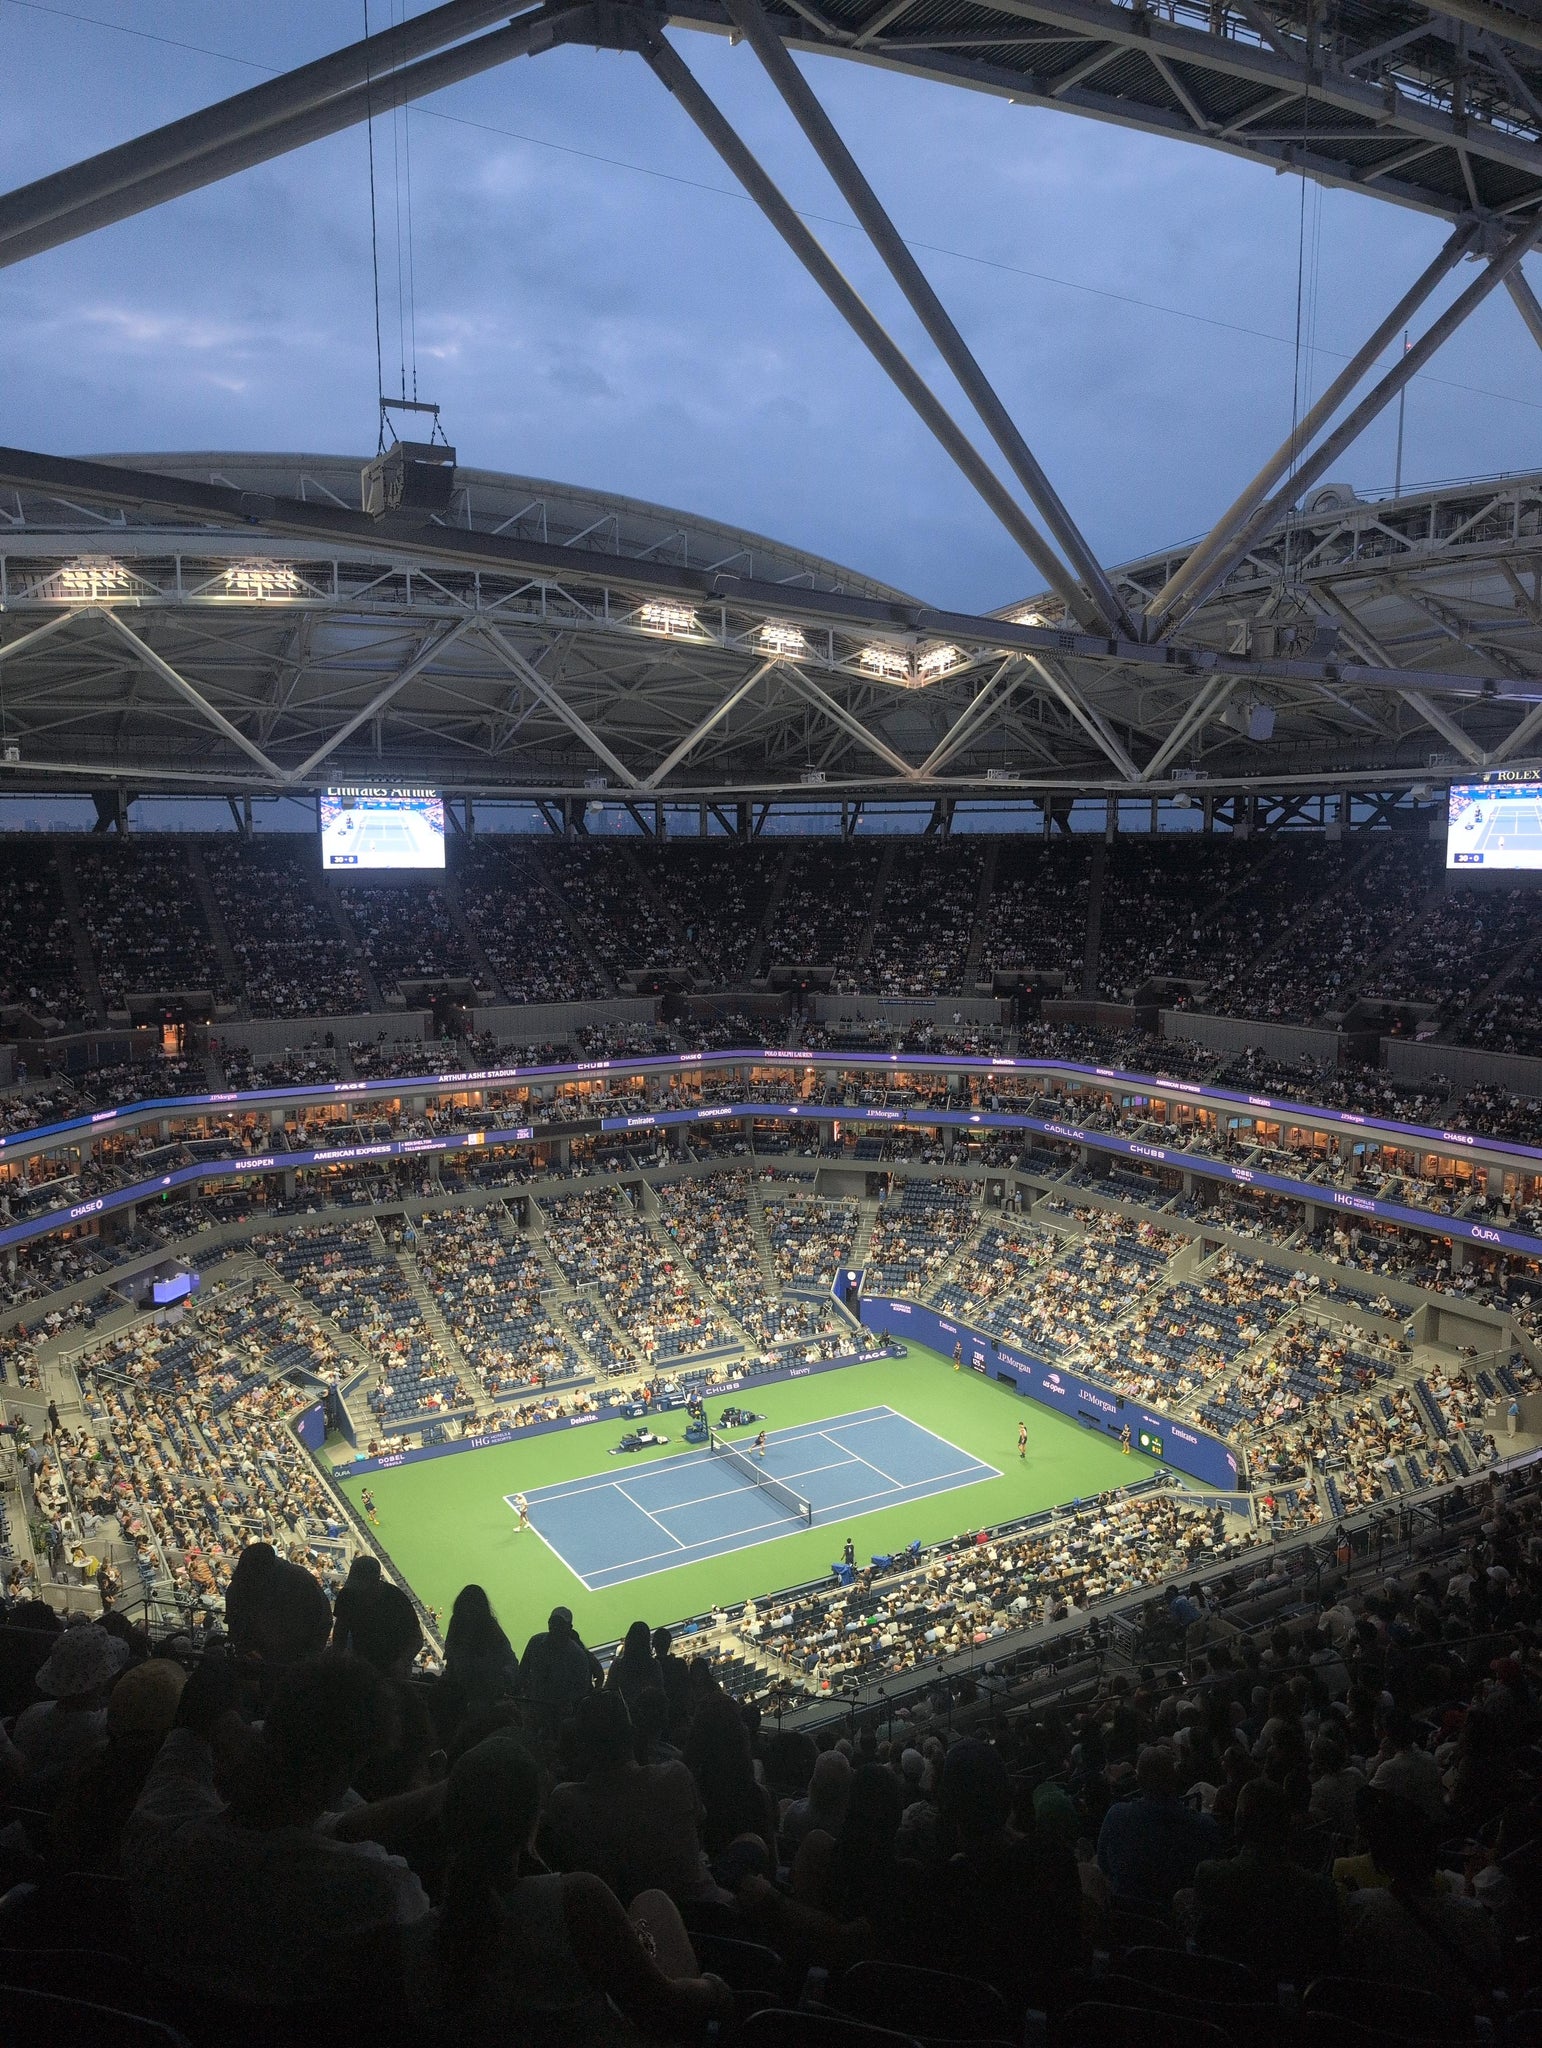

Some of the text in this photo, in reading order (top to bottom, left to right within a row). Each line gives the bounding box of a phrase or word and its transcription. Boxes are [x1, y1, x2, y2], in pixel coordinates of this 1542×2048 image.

[1497, 769, 1541, 780] ROLEX
[578, 1062, 610, 1070] CHUBB
[438, 1070, 516, 1082] ARTHUR ASHE STADIUM
[1156, 1080, 1201, 1092] AMERICAN EXPRESS
[1248, 1096, 1271, 1106] Emirates
[628, 1117, 655, 1126] Emirates
[1044, 1124, 1085, 1139] CADILLAC
[1443, 1132, 1467, 1143] CHASE
[314, 1146, 392, 1160] AMERICAN EXPRESS
[1130, 1144, 1166, 1158] CHUBB
[236, 1158, 274, 1168] #USOPEN
[1232, 1168, 1254, 1178] DOBEL
[1334, 1193, 1352, 1206] IHG
[70, 1202, 96, 1218] CHASE
[1353, 1202, 1375, 1210] RESORTS
[939, 1320, 957, 1334] Emirates
[790, 1367, 810, 1376] Harvey
[706, 1382, 740, 1395] CHUBB
[1050, 1385, 1065, 1395] open
[570, 1414, 598, 1425] Deloitte.
[1171, 1426, 1198, 1444] Emirates
[471, 1437, 490, 1448] IHG
[378, 1454, 406, 1464] DOBEL
